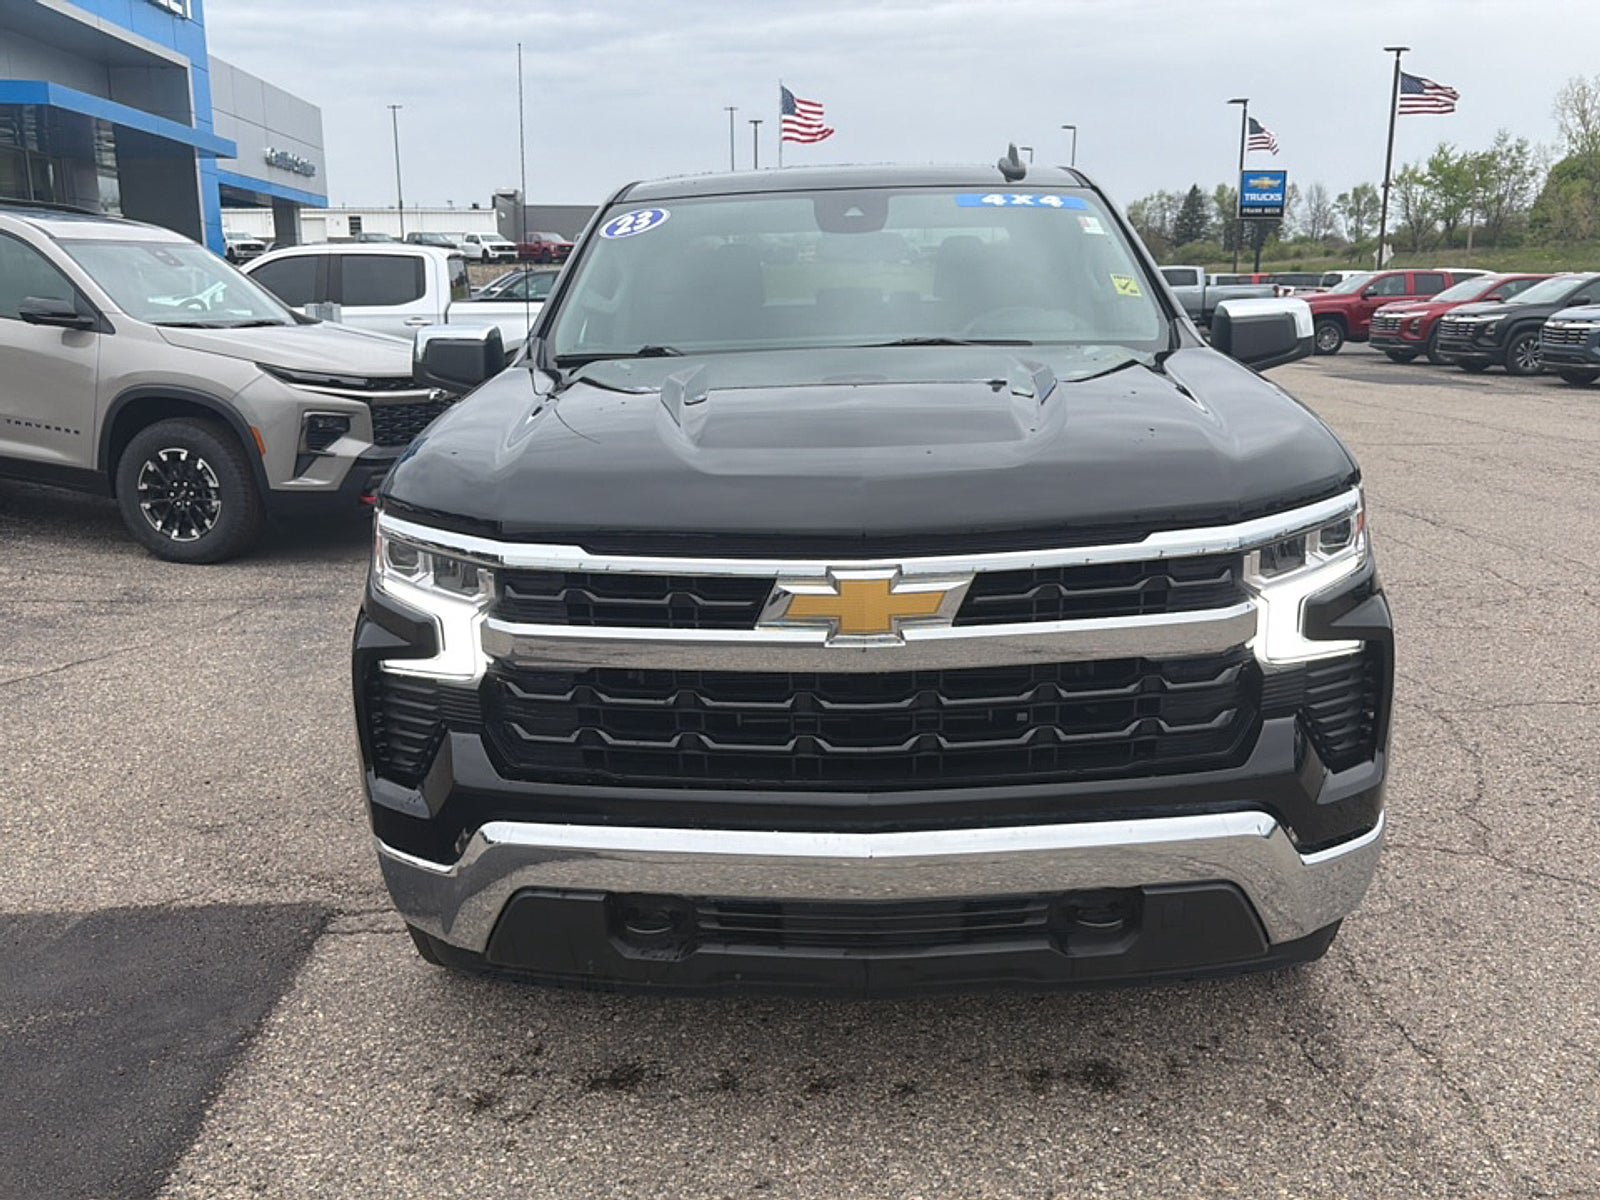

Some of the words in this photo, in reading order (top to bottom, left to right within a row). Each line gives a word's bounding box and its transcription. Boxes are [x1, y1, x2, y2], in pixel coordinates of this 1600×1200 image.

[1244, 193, 1282, 201] TRUCKS
[613, 211, 653, 235] 23
[6, 419, 80, 435] TRAVERSE
